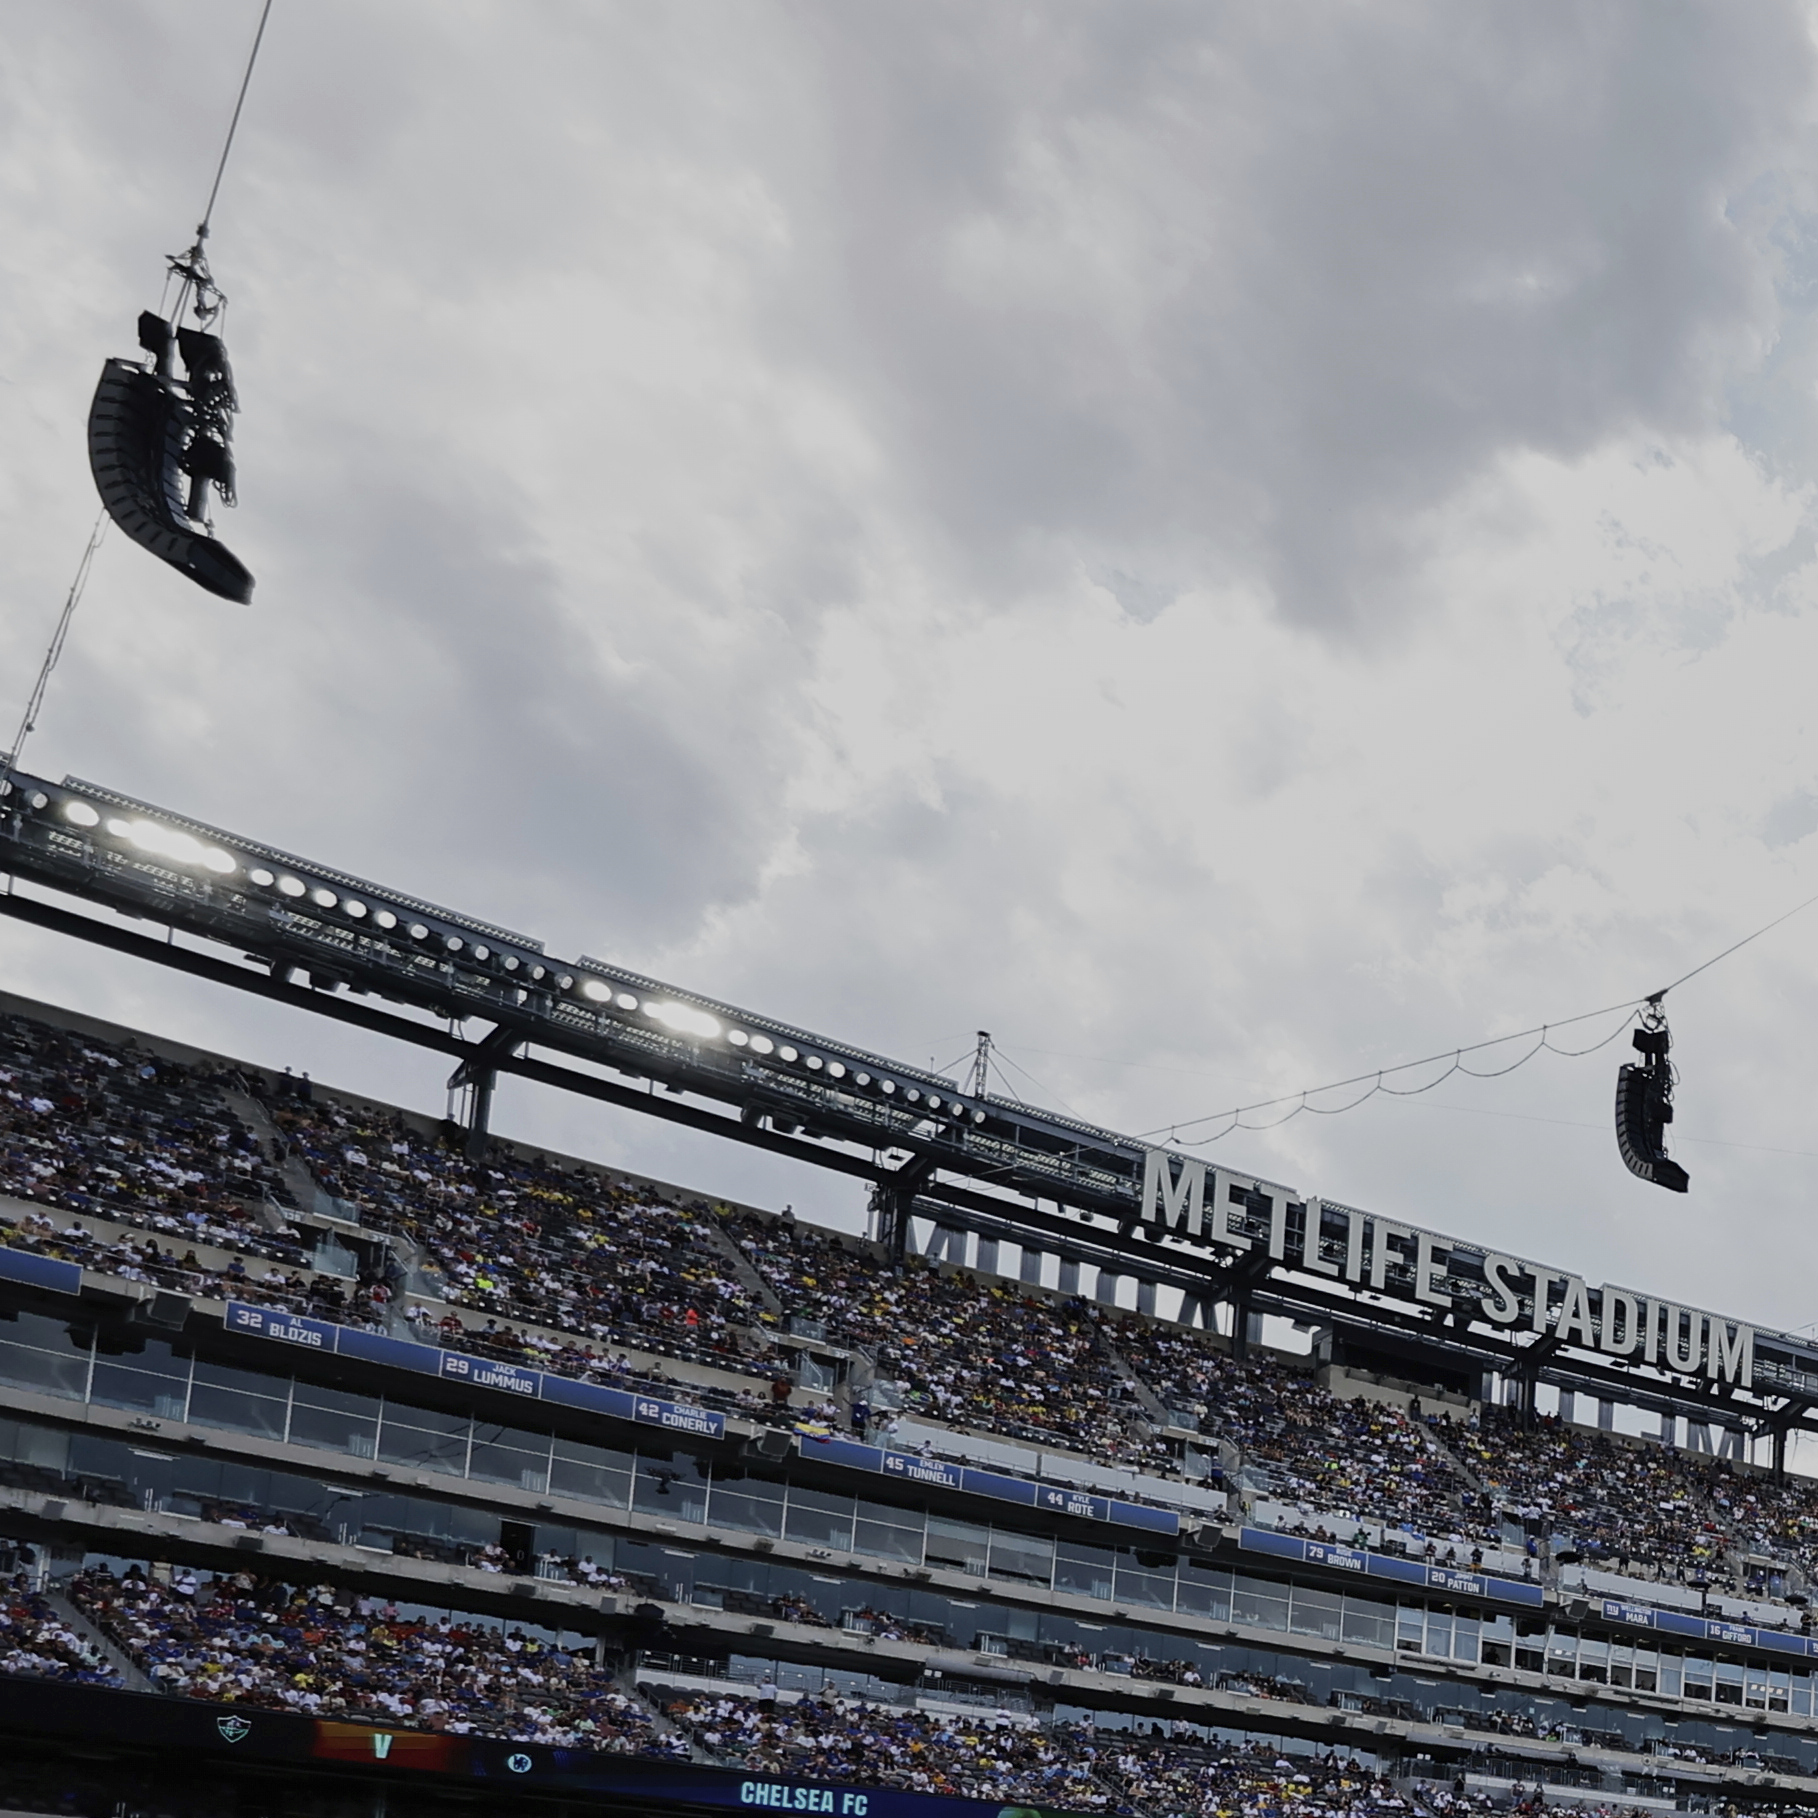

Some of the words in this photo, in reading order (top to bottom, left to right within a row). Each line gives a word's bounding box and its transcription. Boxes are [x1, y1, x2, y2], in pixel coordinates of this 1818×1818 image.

[1140, 1150, 1455, 1308] METLIFE
[1481, 1253, 1755, 1388] STADIUM
[237, 1310, 262, 1328] 32
[269, 1323, 323, 1346] BLOZIS
[446, 1357, 469, 1375] 29
[493, 1364, 517, 1377] JACK
[474, 1369, 534, 1394] LUMMUS
[638, 1402, 659, 1418] 42
[662, 1412, 718, 1434] CONERLY
[886, 1456, 904, 1471] 45
[907, 1464, 955, 1486] TUNNELL
[1047, 1492, 1064, 1506] 44
[1068, 1502, 1095, 1517] ROTE
[1309, 1546, 1324, 1559] 79
[1328, 1554, 1361, 1570] BROWN
[1431, 1571, 1446, 1583] 20
[1447, 1578, 1480, 1594] PATTON
[1626, 1612, 1649, 1625] MARA
[1710, 1624, 1721, 1635] 16
[373, 1732, 394, 1759] V
[740, 1781, 835, 1813] CHELSEA
[841, 1792, 869, 1817] FC
